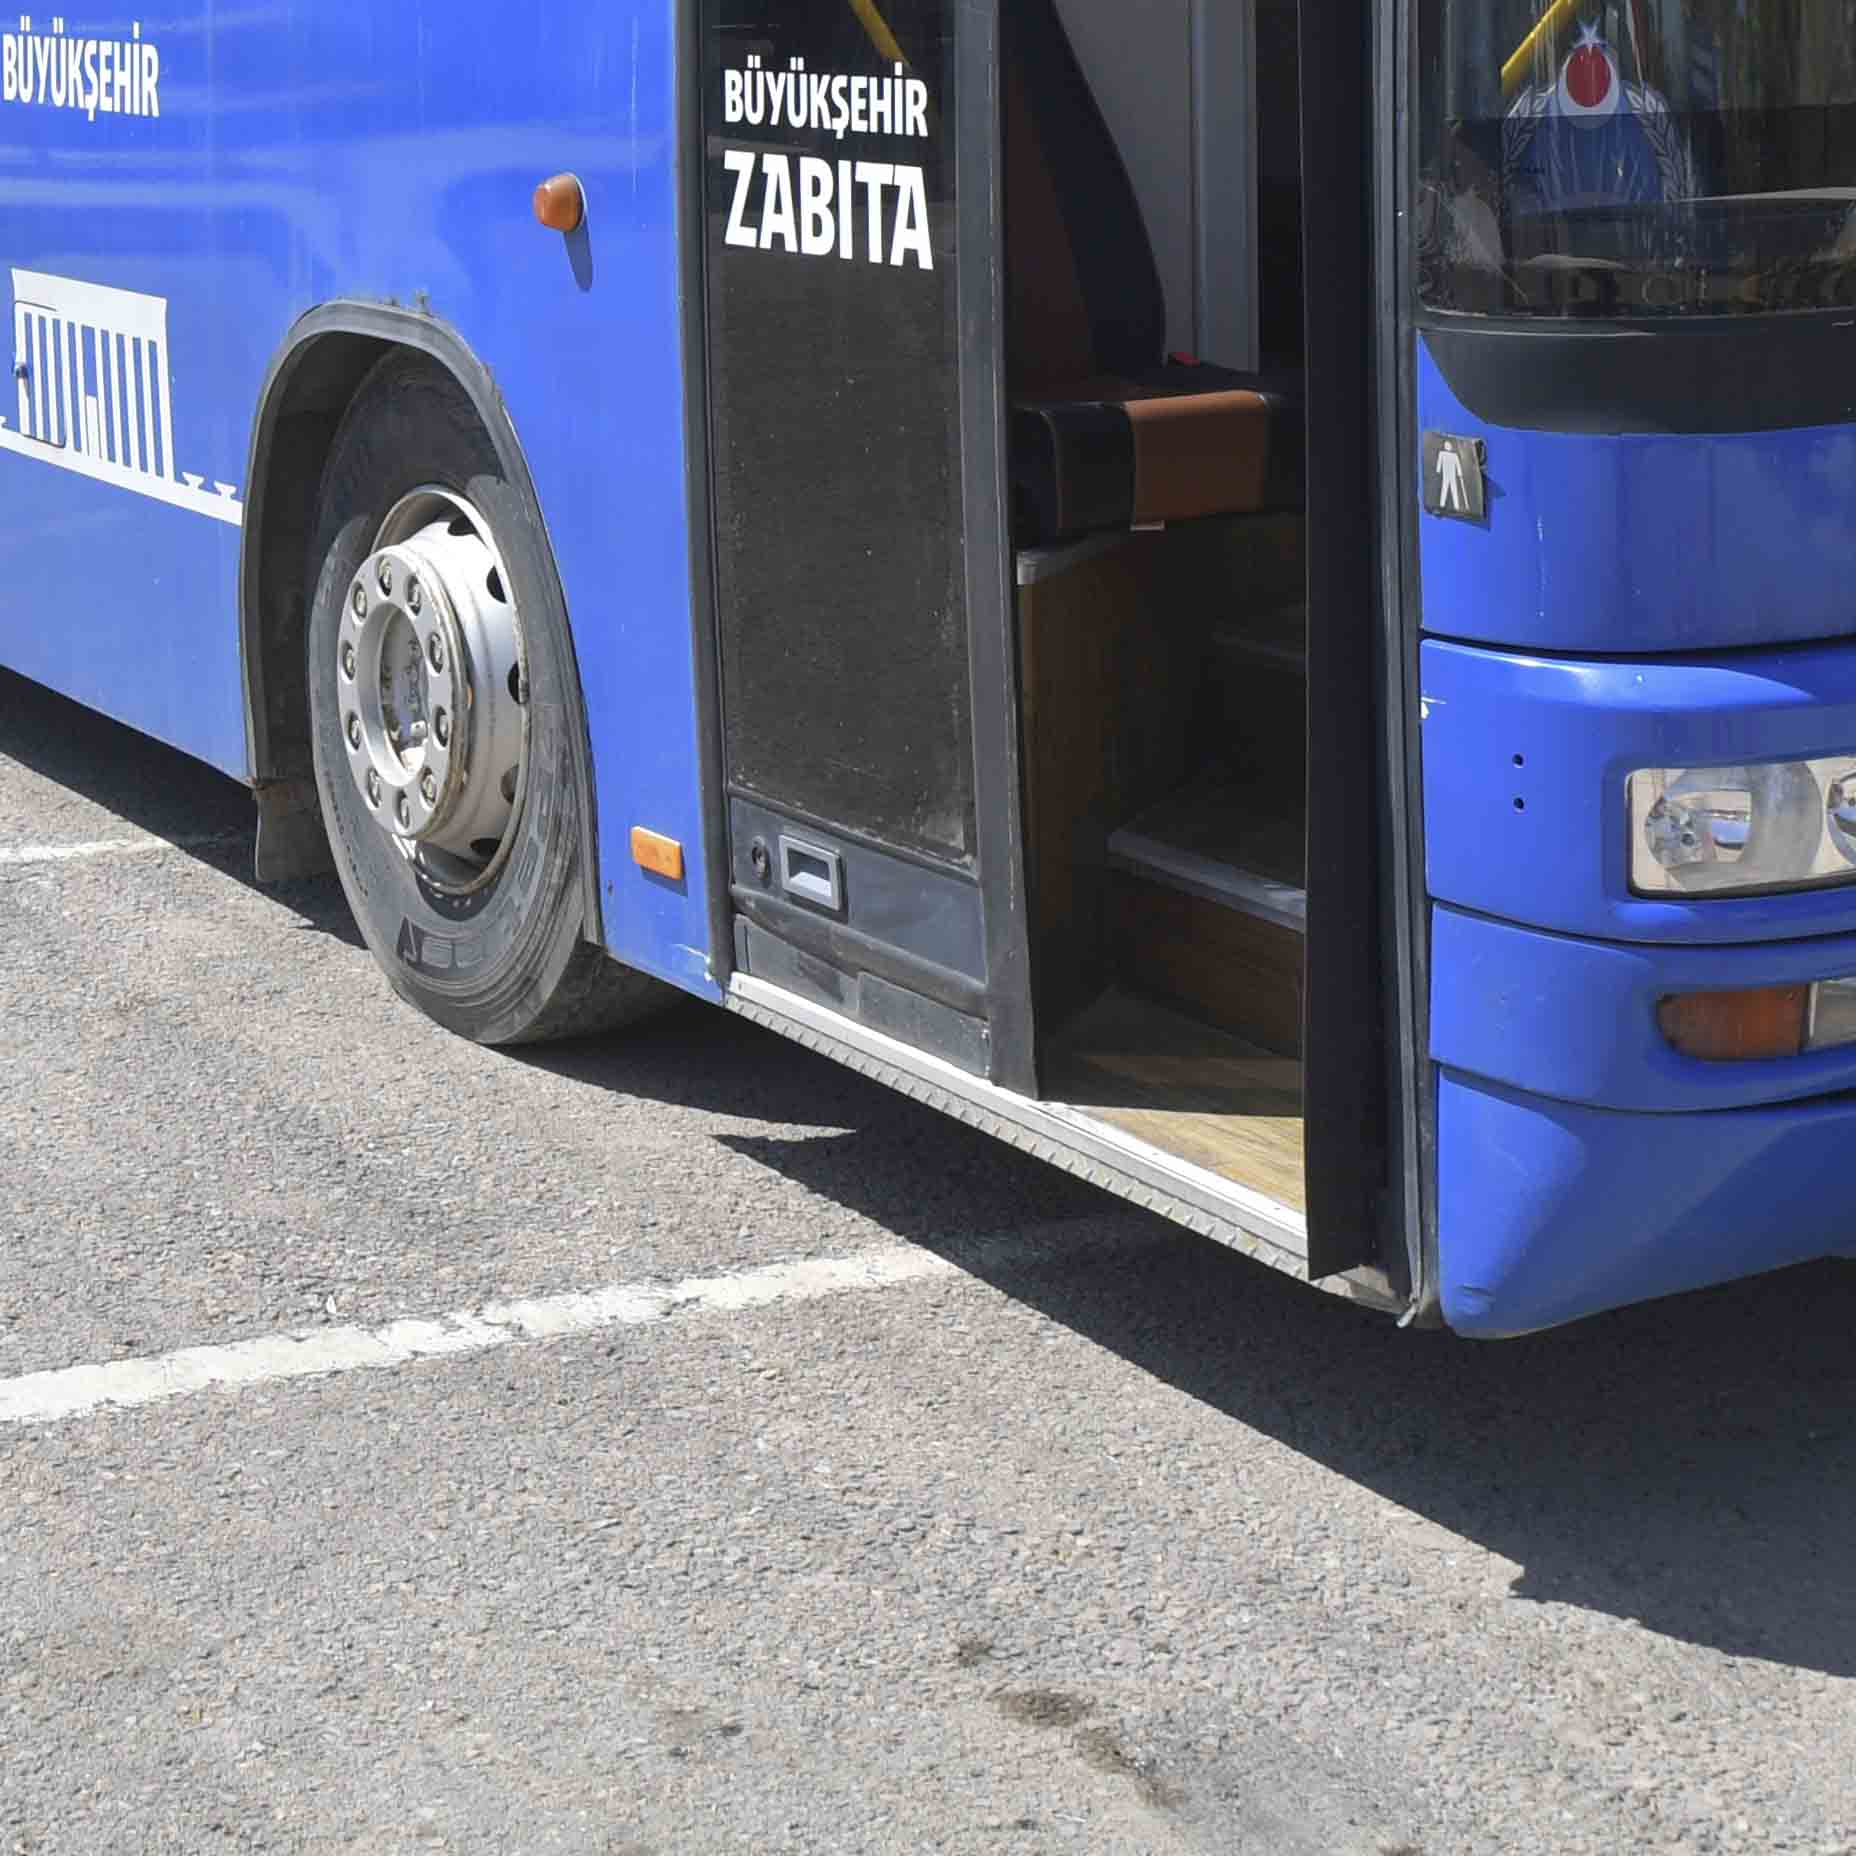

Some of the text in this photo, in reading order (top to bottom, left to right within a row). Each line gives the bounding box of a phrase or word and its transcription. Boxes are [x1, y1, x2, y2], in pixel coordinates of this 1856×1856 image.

[1, 15, 161, 121] BÜYÜKŞEHİR
[723, 55, 929, 139] BÜYÜKŞEHİR
[723, 149, 934, 271] ZABITA
